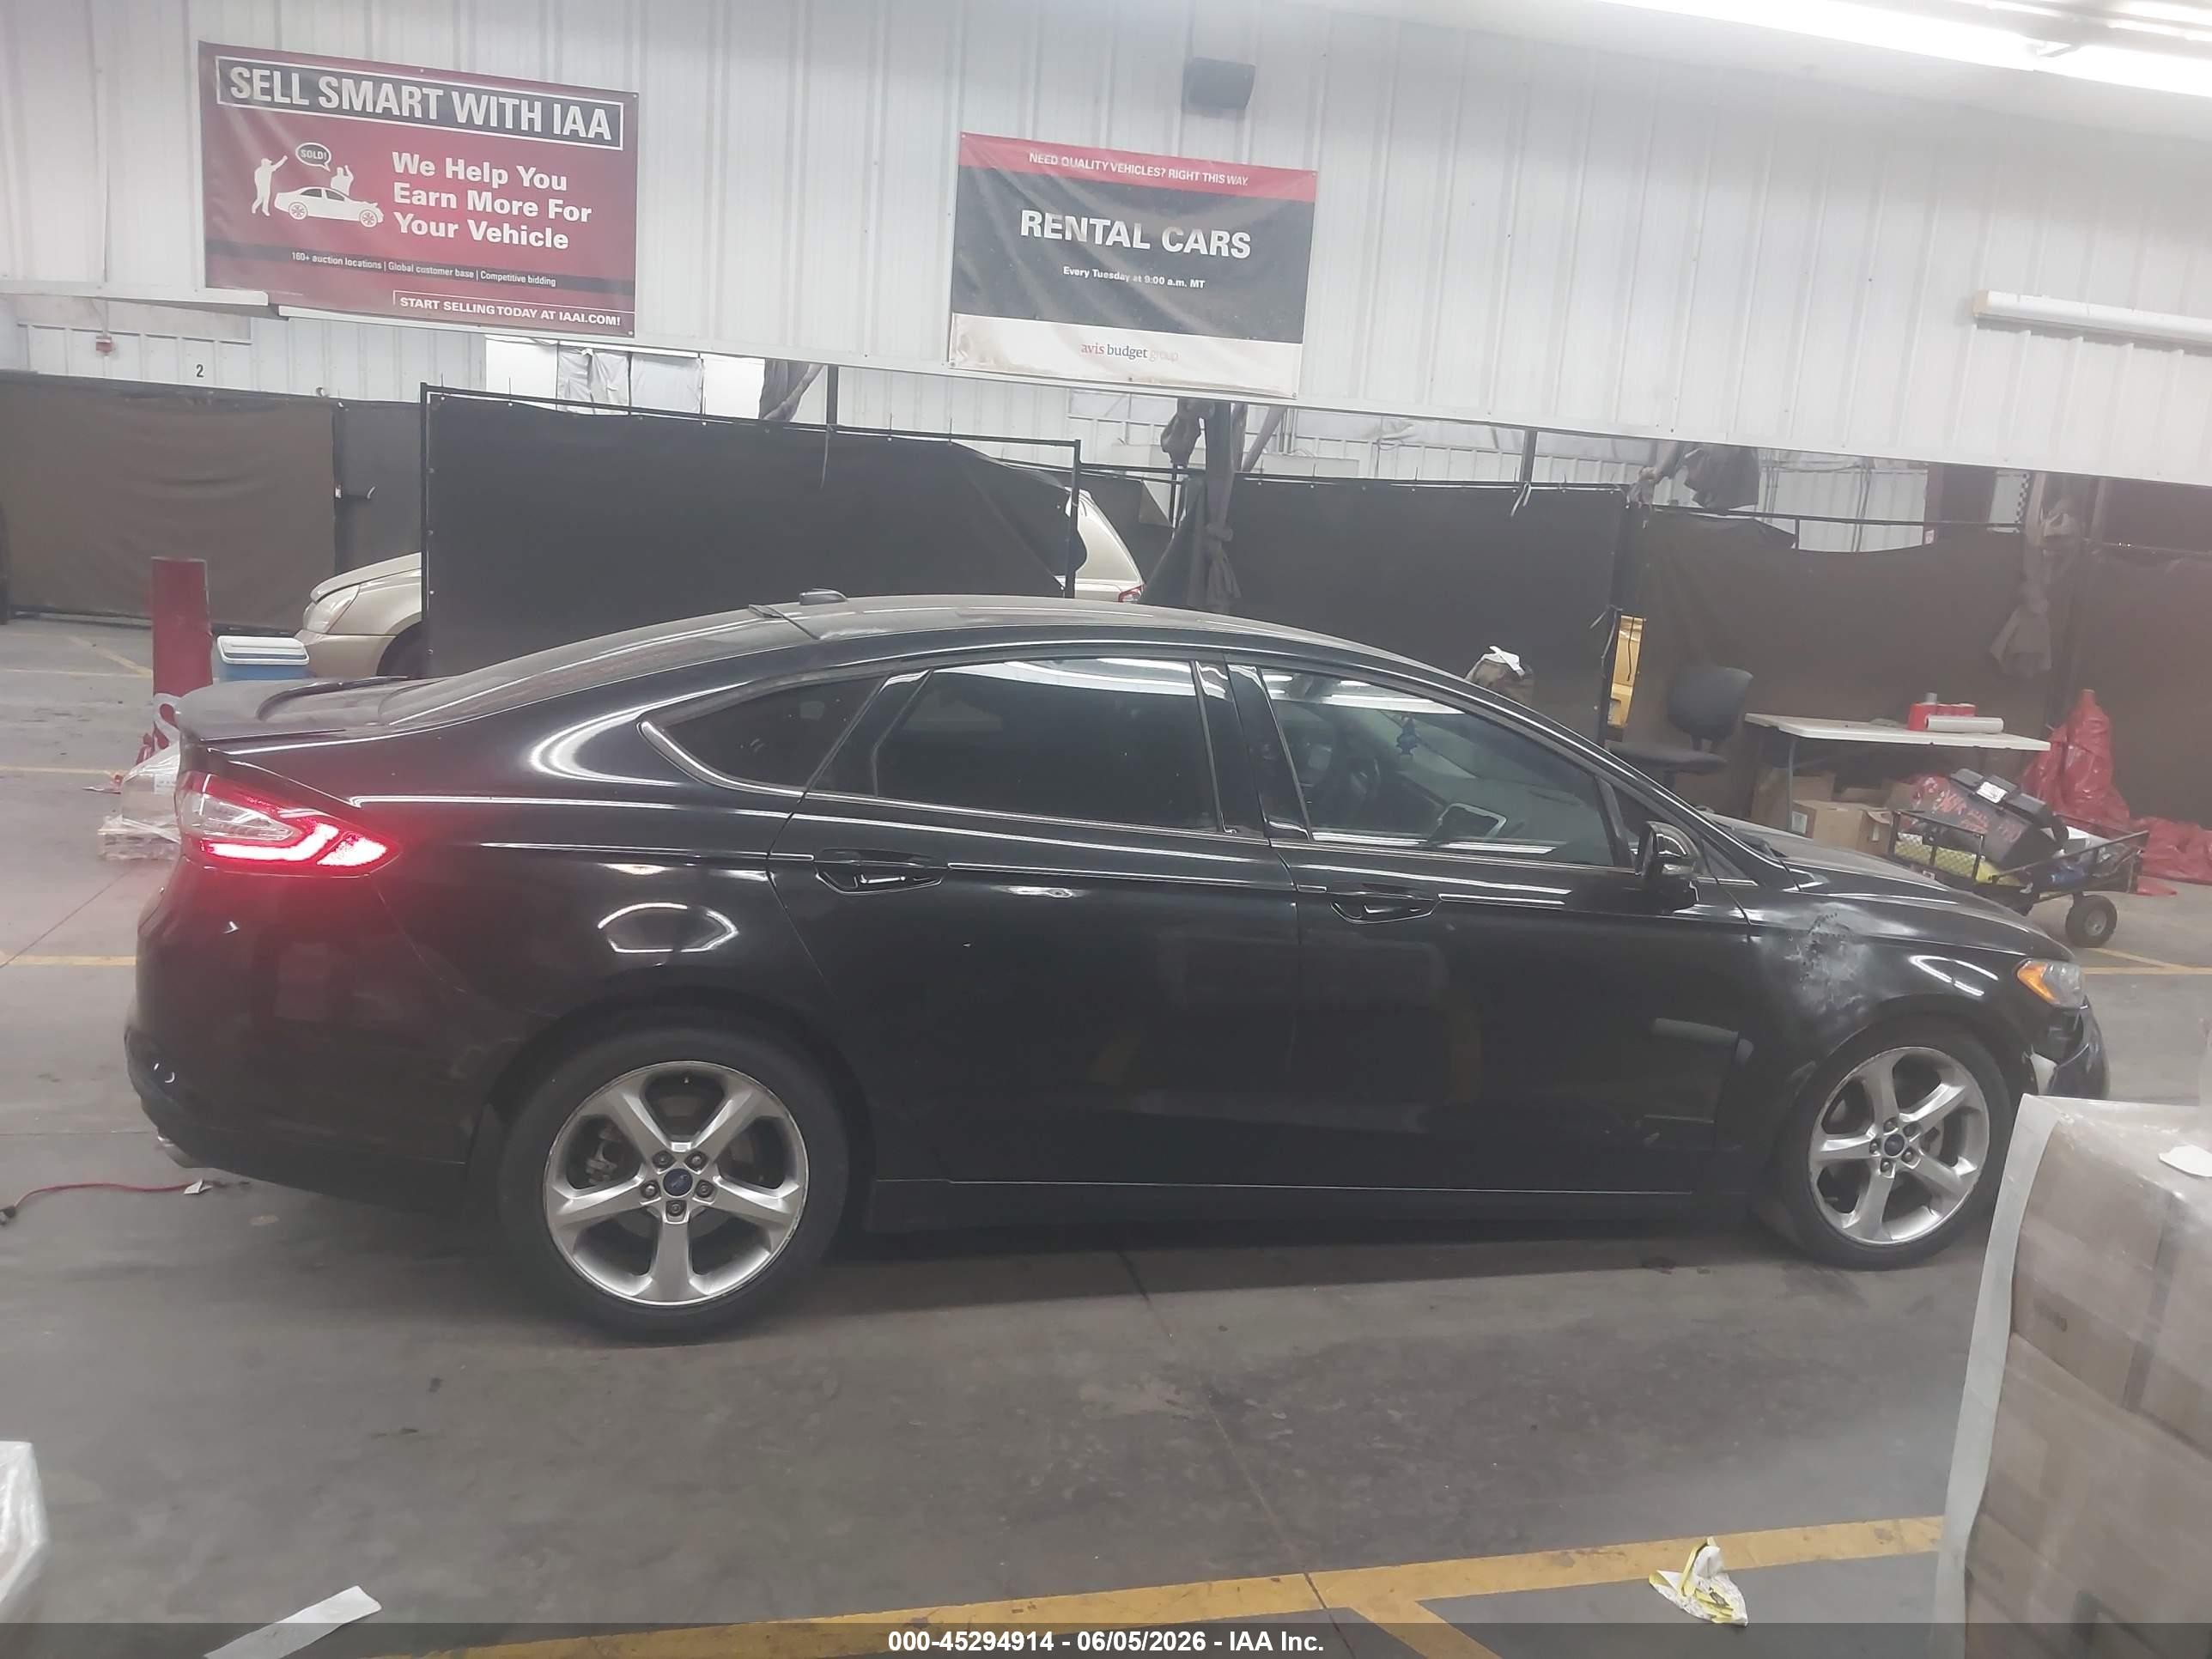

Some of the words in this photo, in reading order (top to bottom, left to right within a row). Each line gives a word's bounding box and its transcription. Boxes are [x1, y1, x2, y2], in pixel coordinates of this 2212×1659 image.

[229, 66, 310, 106] SELL
[318, 76, 444, 120] SMART
[451, 90, 542, 132] WITH
[553, 103, 612, 140] IAA
[301, 149, 327, 161] SOLD!
[392, 151, 435, 177] We
[445, 157, 508, 189] Help
[516, 165, 568, 191] You
[1029, 152, 1059, 165] NEED
[1060, 156, 1109, 171] QUALITY
[1110, 162, 1166, 178] VEHICLES?
[1168, 168, 1200, 182] RIGHT
[1202, 172, 1225, 184] THIS
[393, 182, 458, 209] Earn
[467, 190, 538, 217] More
[548, 198, 592, 222] For
[393, 211, 459, 238] Your
[467, 219, 568, 250] Vehicle
[1019, 209, 1151, 251] RENTAL
[1161, 226, 1252, 259] CARS
[312, 255, 343, 265] auction
[344, 258, 382, 270] locations
[388, 261, 414, 273] Global
[416, 265, 453, 276] customer
[455, 268, 475, 278] base
[480, 270, 526, 283] Competitive
[527, 276, 556, 288] bidding
[1063, 266, 1090, 279] Every
[1092, 269, 1130, 283] Tuesday
[1144, 276, 1165, 285] 9:00
[1167, 277, 1188, 288] a.m.
[1189, 279, 1206, 289] MT
[399, 297, 440, 310] START
[443, 301, 495, 314] SELLING
[496, 307, 538, 319] TODAY
[540, 310, 556, 320] AT
[559, 312, 621, 326] IAAI.COM!
[1081, 343, 1105, 355] avis
[1107, 343, 1148, 361] budget
[196, 363, 204, 378] 2
